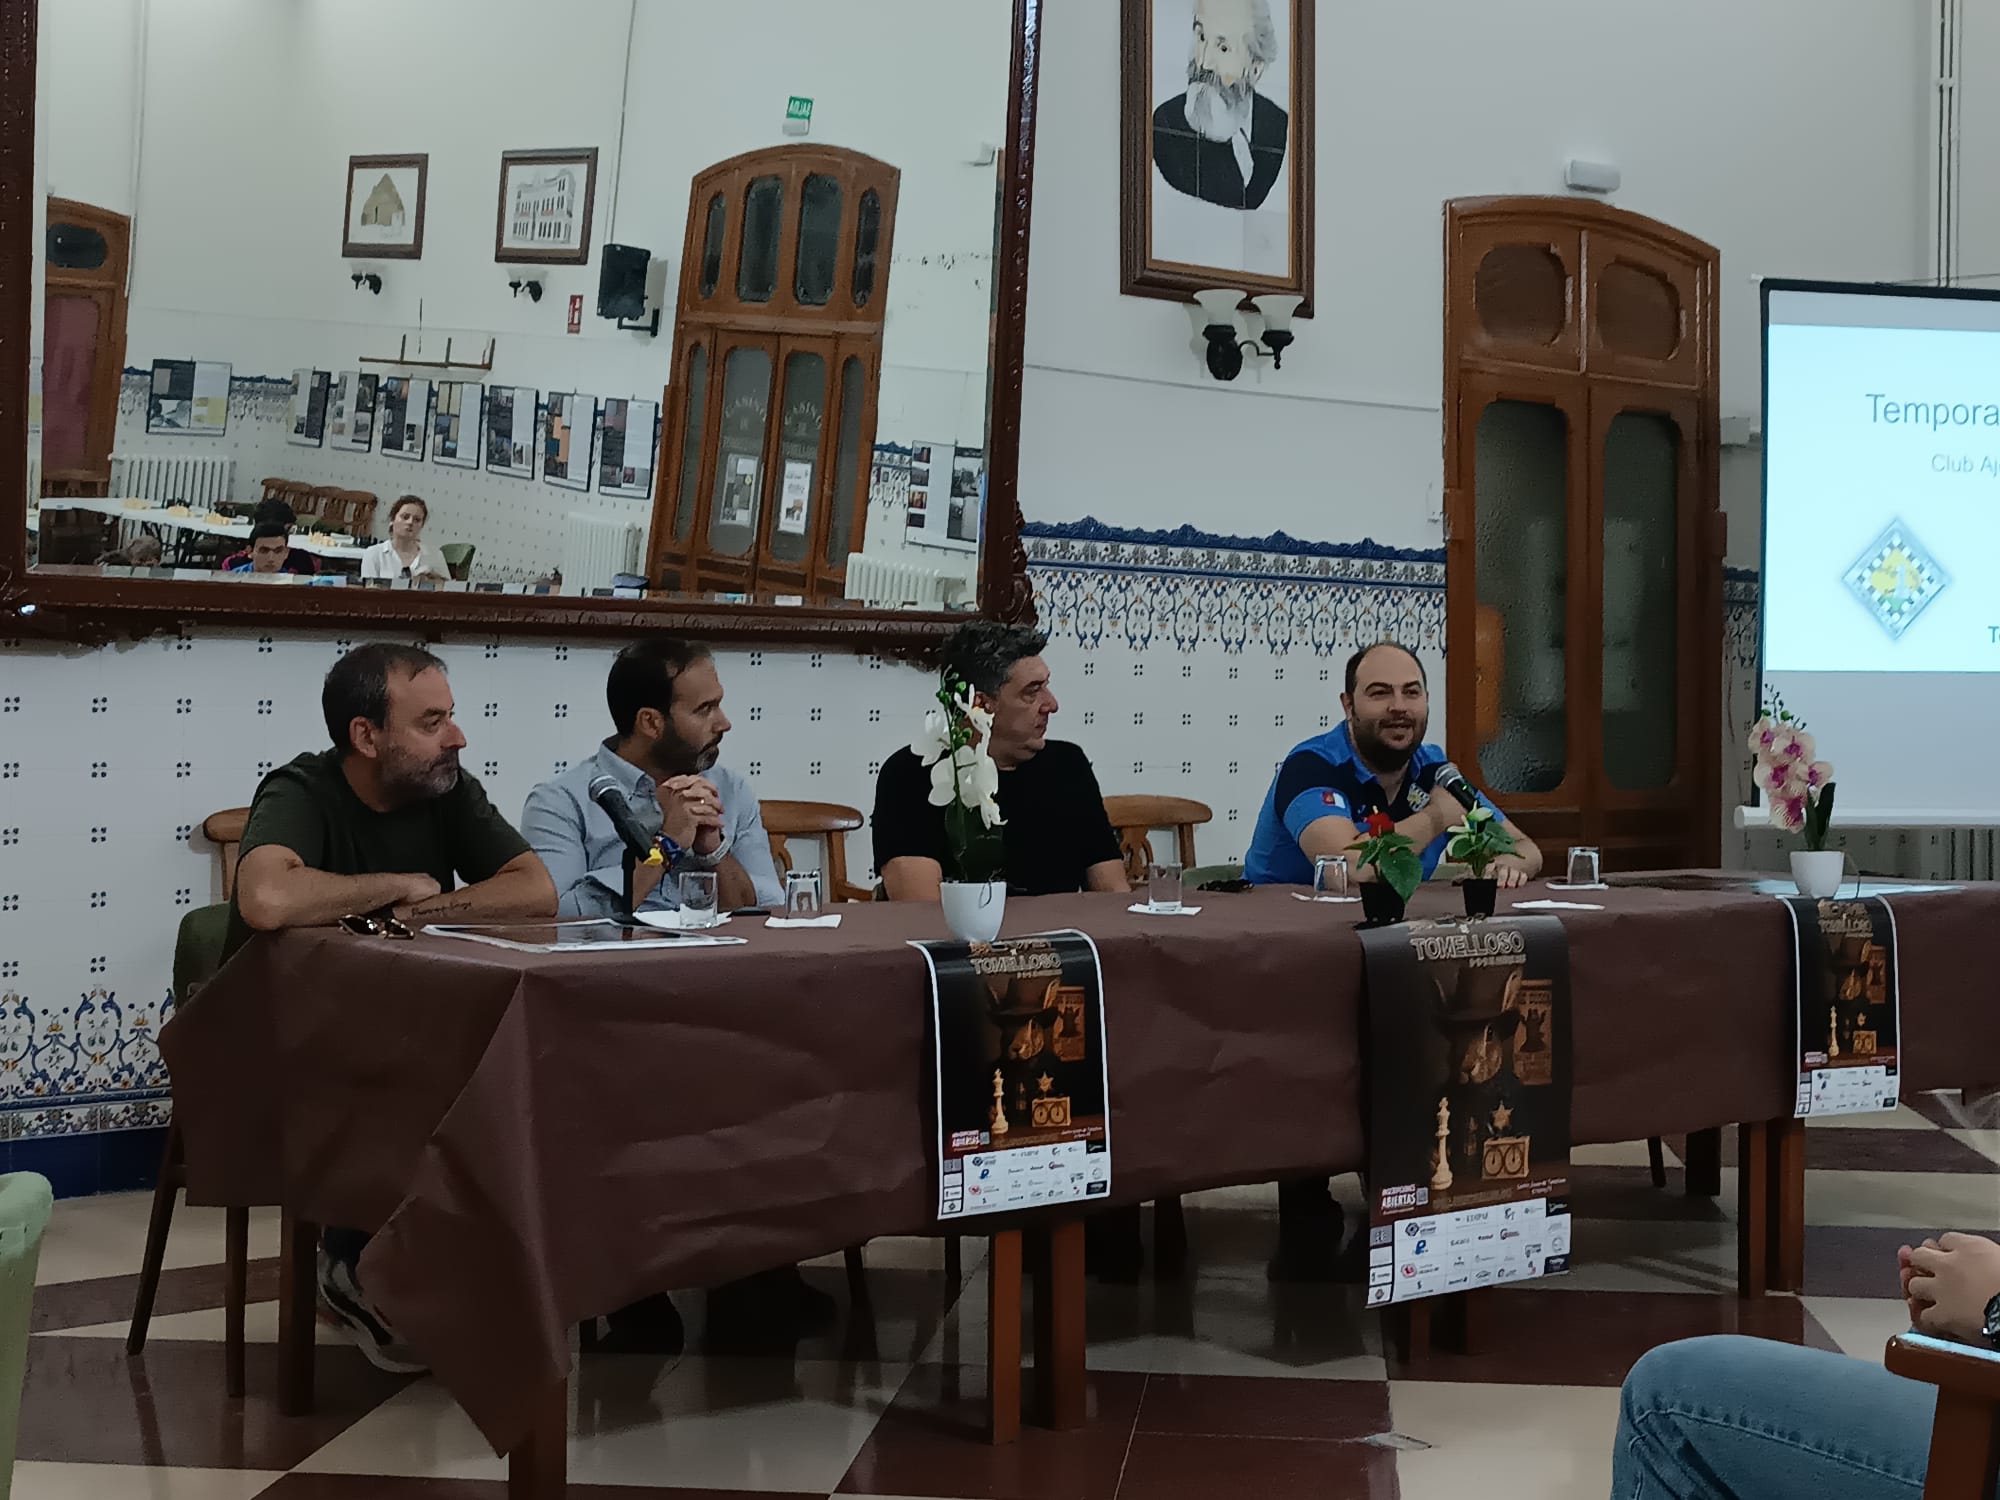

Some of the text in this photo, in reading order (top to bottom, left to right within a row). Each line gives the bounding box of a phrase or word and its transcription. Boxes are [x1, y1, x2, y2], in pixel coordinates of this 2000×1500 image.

[1866, 393, 2000, 432] Tempora
[1931, 453, 2000, 478] Club Aj
[1987, 625, 2000, 644] T
[1409, 930, 1525, 961] TOMELLOSO
[970, 952, 1062, 975] TOMELLOSO
